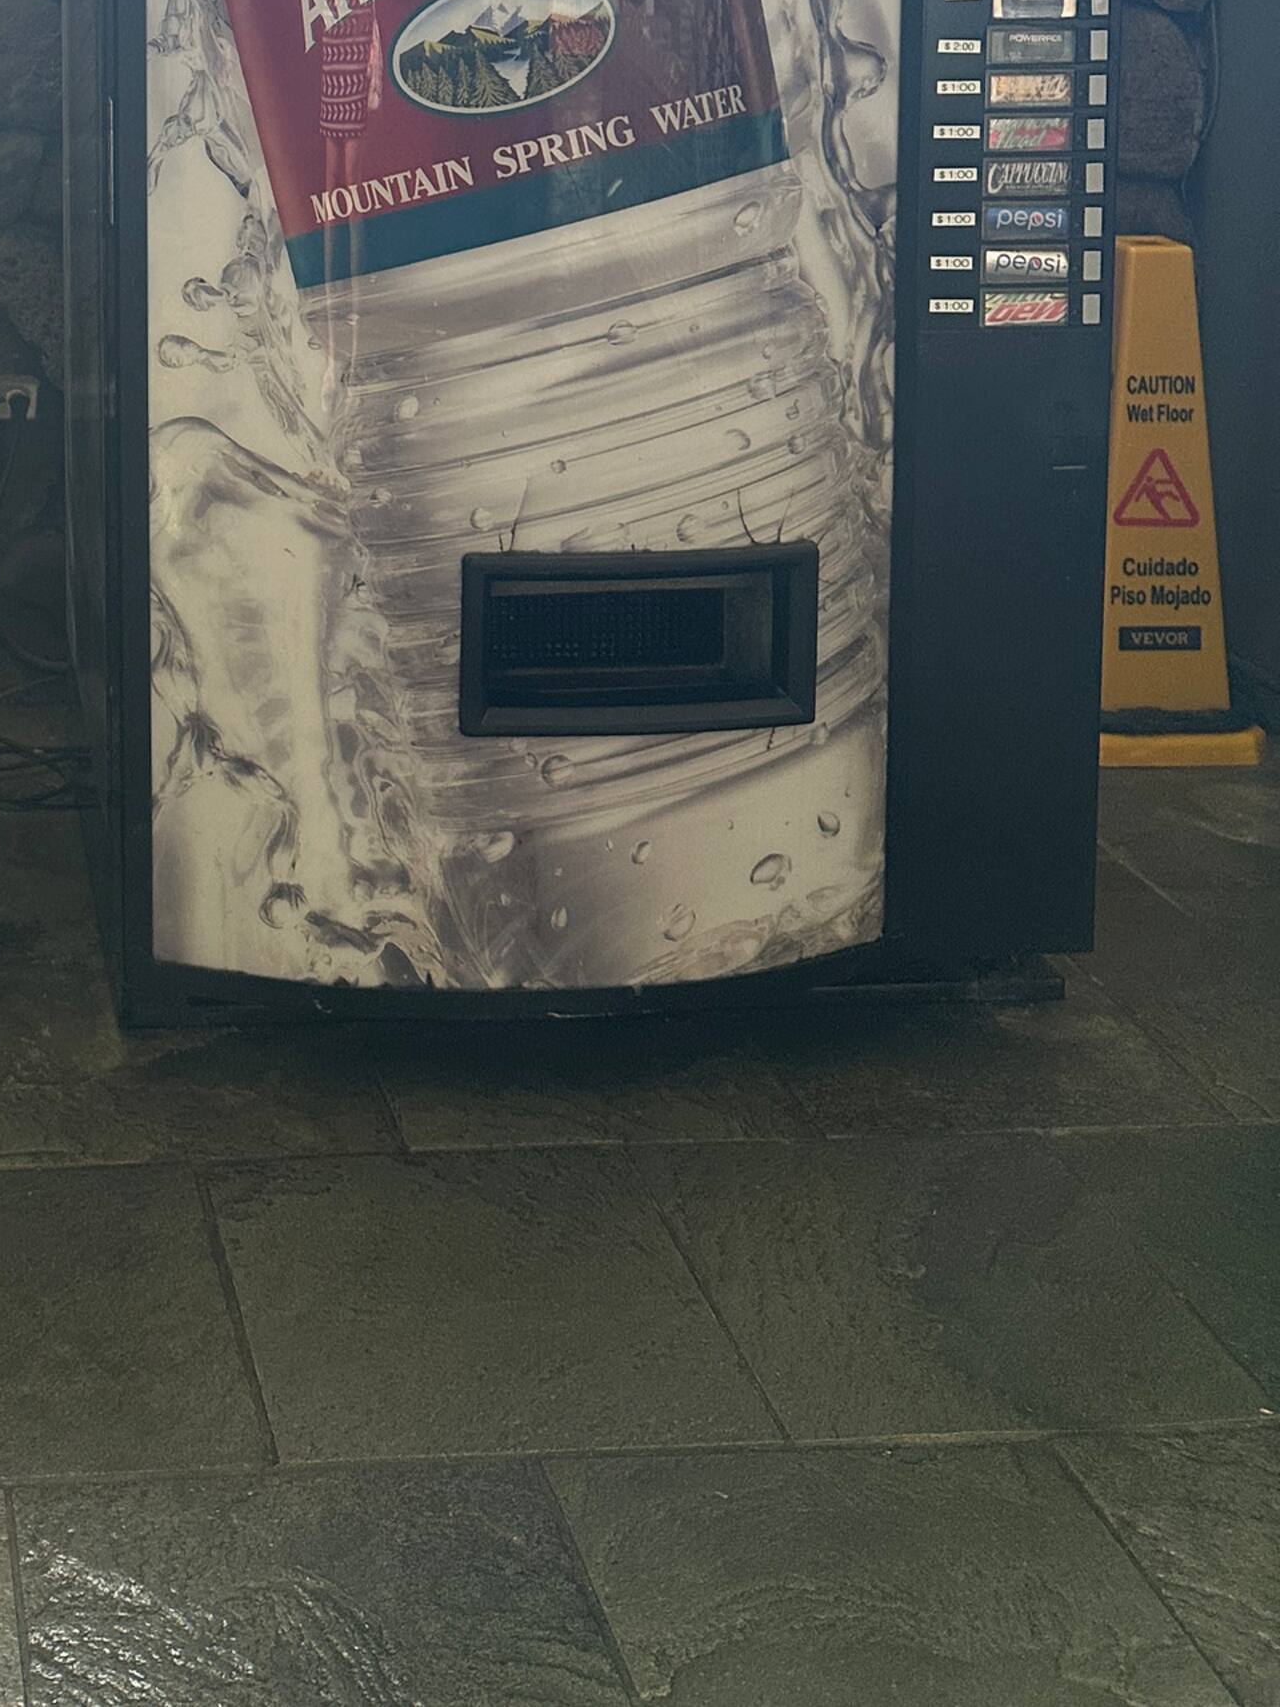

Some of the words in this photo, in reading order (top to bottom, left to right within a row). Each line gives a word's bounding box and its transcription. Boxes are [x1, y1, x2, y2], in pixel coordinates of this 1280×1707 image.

[310, 156, 475, 225] MOUNTAIN
[494, 115, 637, 181] SPRING
[650, 83, 747, 136] WATER
[996, 206, 1063, 231] pepsi
[995, 253, 1062, 276] pepsi
[1127, 375, 1195, 395] CAUTION
[1127, 404, 1153, 423] Wet
[1156, 404, 1194, 424] Floor
[1122, 557, 1199, 579] Cuidado
[1110, 585, 1148, 606] Piso
[1151, 585, 1212, 610] Mojado
[1131, 631, 1189, 646] VEVOR
